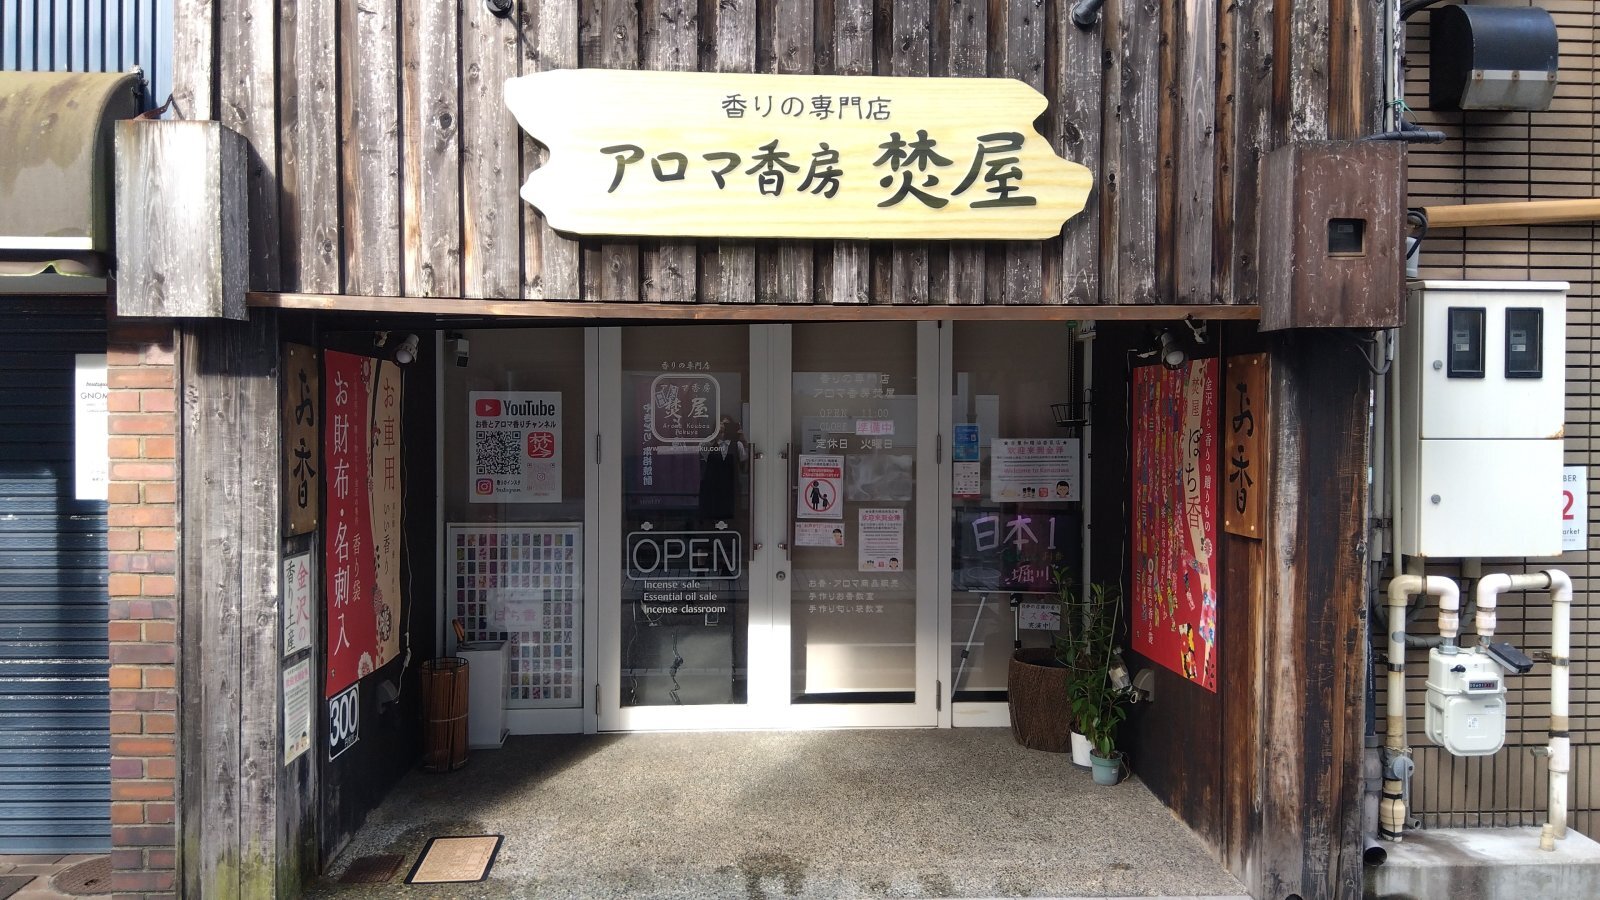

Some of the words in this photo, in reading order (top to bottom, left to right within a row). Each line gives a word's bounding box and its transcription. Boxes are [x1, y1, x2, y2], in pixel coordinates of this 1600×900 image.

[721, 94, 892, 121] 香りの専門店
[600, 139, 843, 200] アロマ香房
[873, 129, 1037, 209] 焚屋
[660, 384, 711, 393] アマ香房
[503, 400, 555, 416] YouTube
[476, 420, 556, 429] お香とアロマ香りチャンネル
[293, 368, 316, 508] お香
[816, 438, 848, 449] 定休日
[860, 438, 893, 449] 火曜日
[1229, 381, 1254, 514] お香
[633, 538, 736, 573] OPEN
[644, 580, 678, 589] Incense
[682, 580, 700, 589] sale
[643, 592, 682, 601] Essential
[685, 592, 696, 601] oil
[699, 592, 718, 601] sale
[644, 604, 678, 614] Incense
[681, 604, 726, 614] classroom
[330, 688, 358, 747] 300
